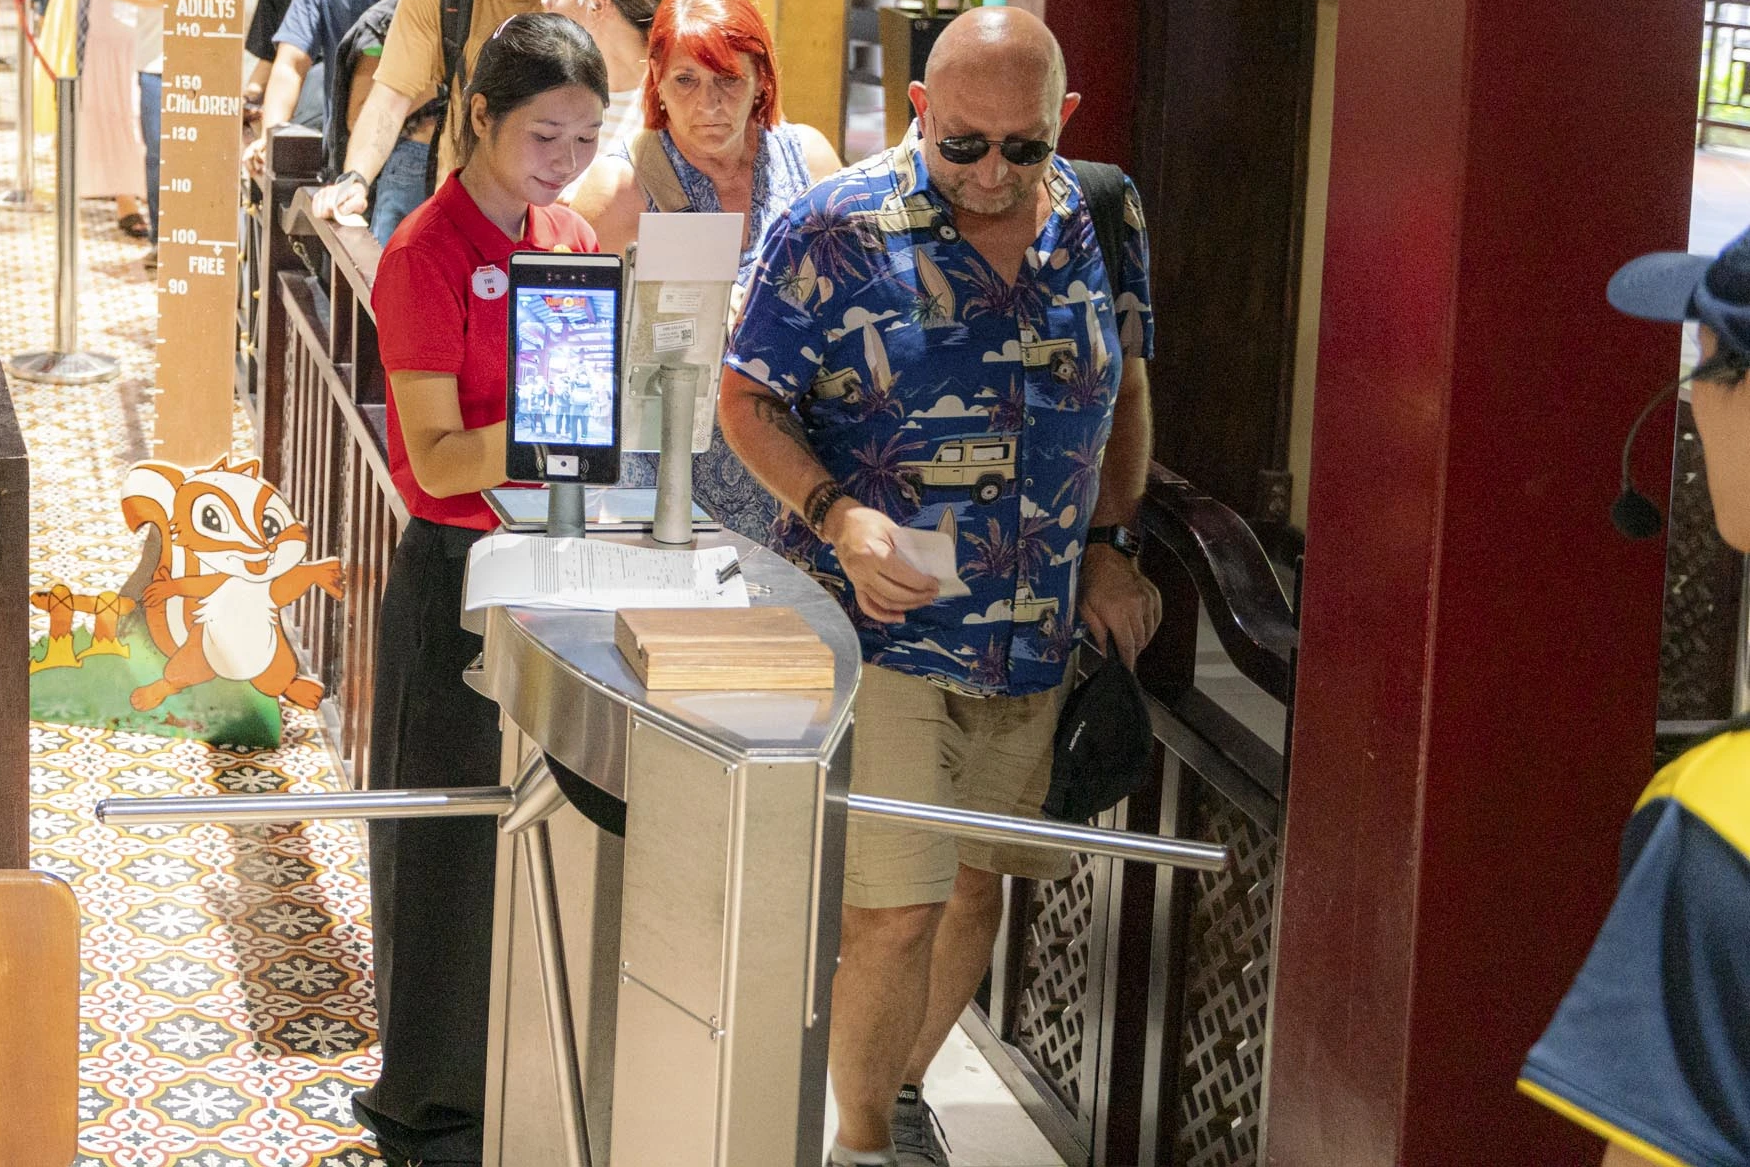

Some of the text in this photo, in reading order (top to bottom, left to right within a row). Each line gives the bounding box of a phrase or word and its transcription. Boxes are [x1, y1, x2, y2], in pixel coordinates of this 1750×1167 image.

[176, 21, 201, 38] 140
[166, 92, 240, 117] CHILDREN
[171, 126, 198, 142] 120
[171, 178, 192, 193] 110
[171, 229, 197, 245] 100
[188, 255, 226, 275] FREE
[167, 279, 188, 295] 90
